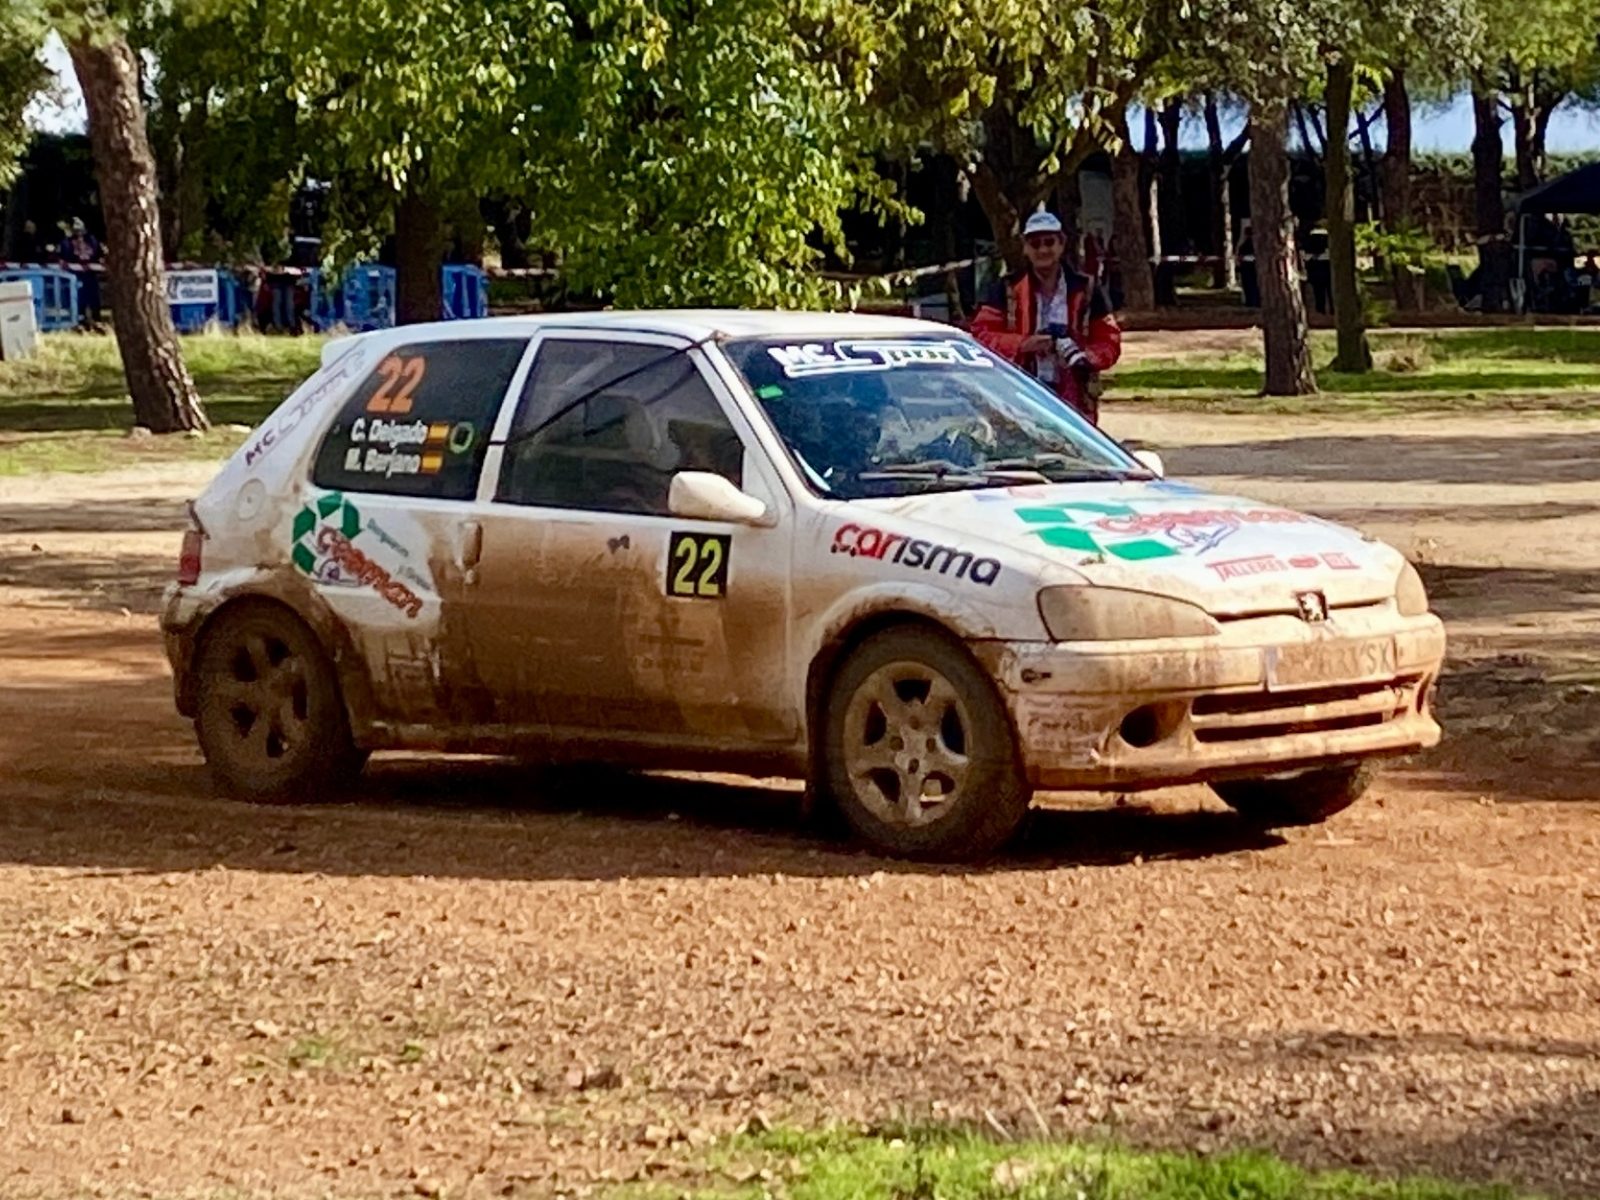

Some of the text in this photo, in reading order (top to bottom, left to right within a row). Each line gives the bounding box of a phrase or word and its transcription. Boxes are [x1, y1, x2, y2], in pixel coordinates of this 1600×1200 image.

[366, 354, 427, 413] 22
[767, 344, 835, 365] MC
[350, 417, 367, 442] C.
[673, 537, 723, 595] 22
[830, 512, 1001, 586] carisma
